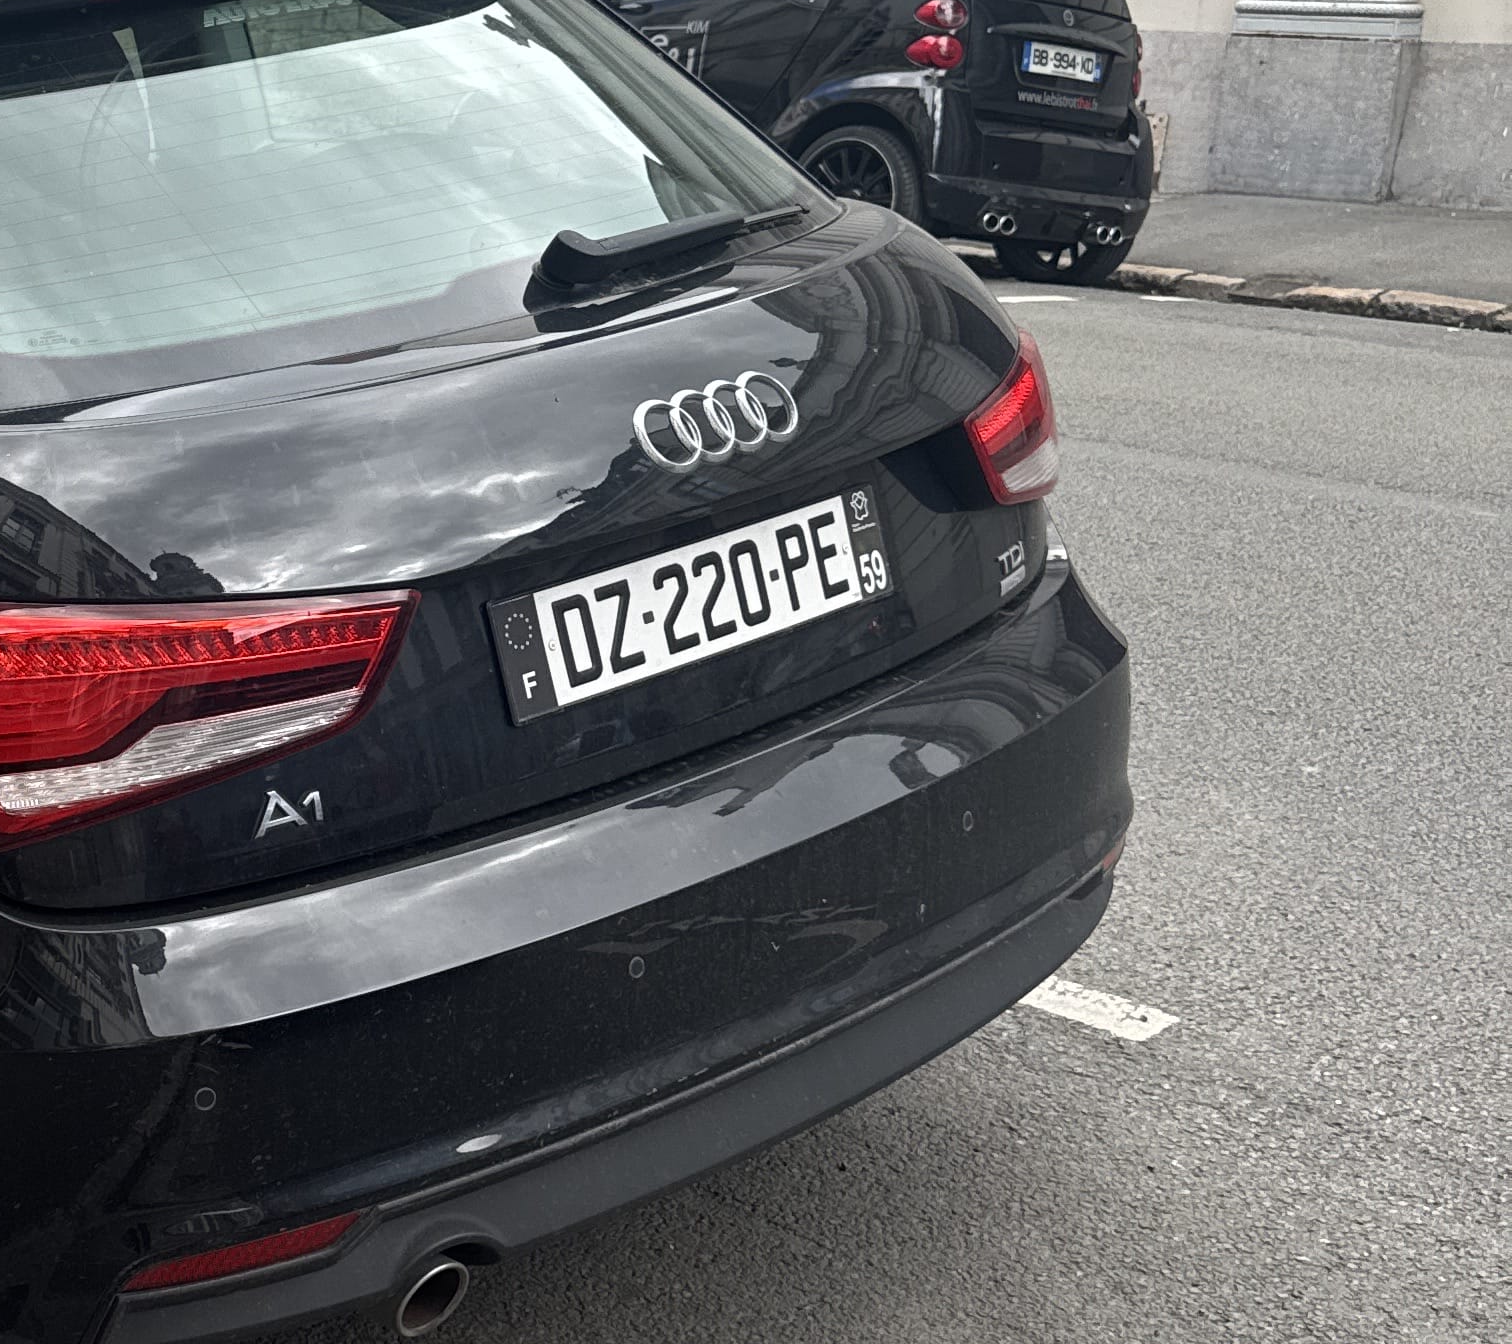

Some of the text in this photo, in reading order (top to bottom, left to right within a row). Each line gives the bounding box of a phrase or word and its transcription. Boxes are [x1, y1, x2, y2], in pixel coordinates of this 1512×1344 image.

[686, 20, 710, 34] KIM
[859, 550, 887, 594] 59
[998, 540, 1025, 575] TDI
[551, 511, 850, 688] DZ-220-PE
[522, 671, 537, 699] F
[254, 790, 324, 840] A1
